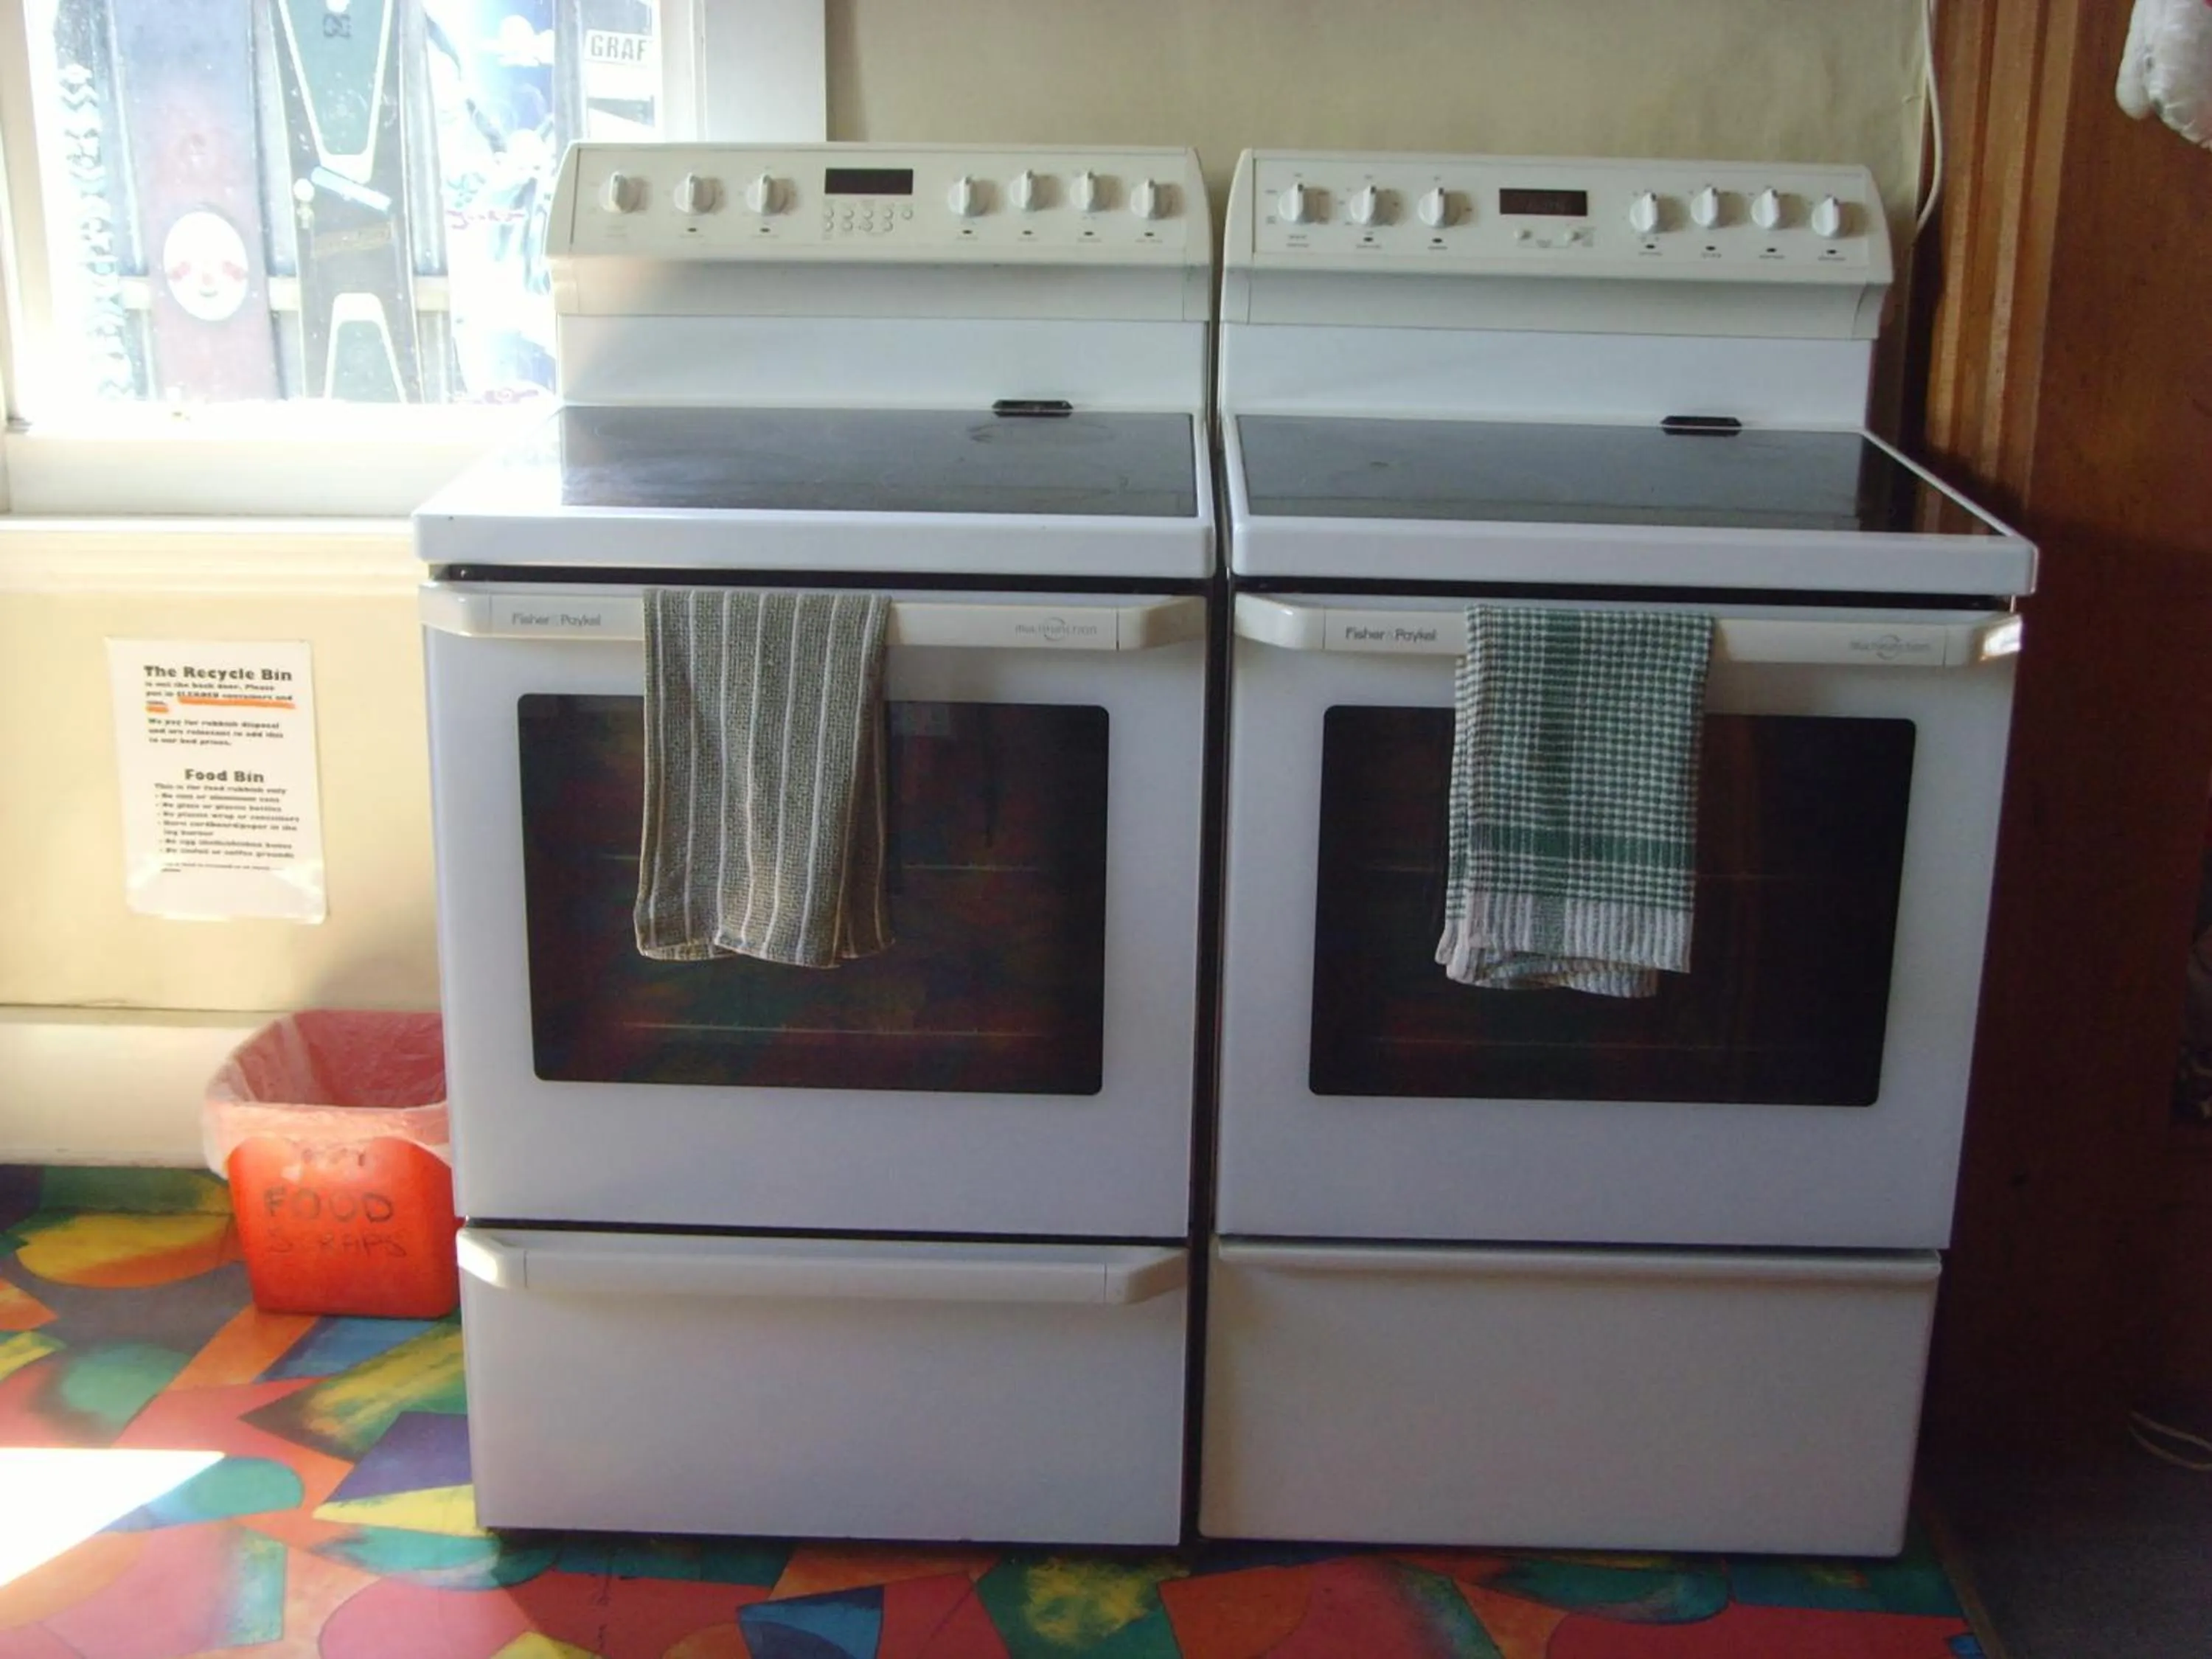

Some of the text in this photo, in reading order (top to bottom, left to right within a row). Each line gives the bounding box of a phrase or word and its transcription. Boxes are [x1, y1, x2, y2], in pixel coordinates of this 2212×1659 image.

[144, 666, 293, 681] The Recycle Bin
[185, 768, 265, 783] Food Bin
[264, 1184, 394, 1223] FOOD
[267, 1225, 408, 1257] SRAPS
